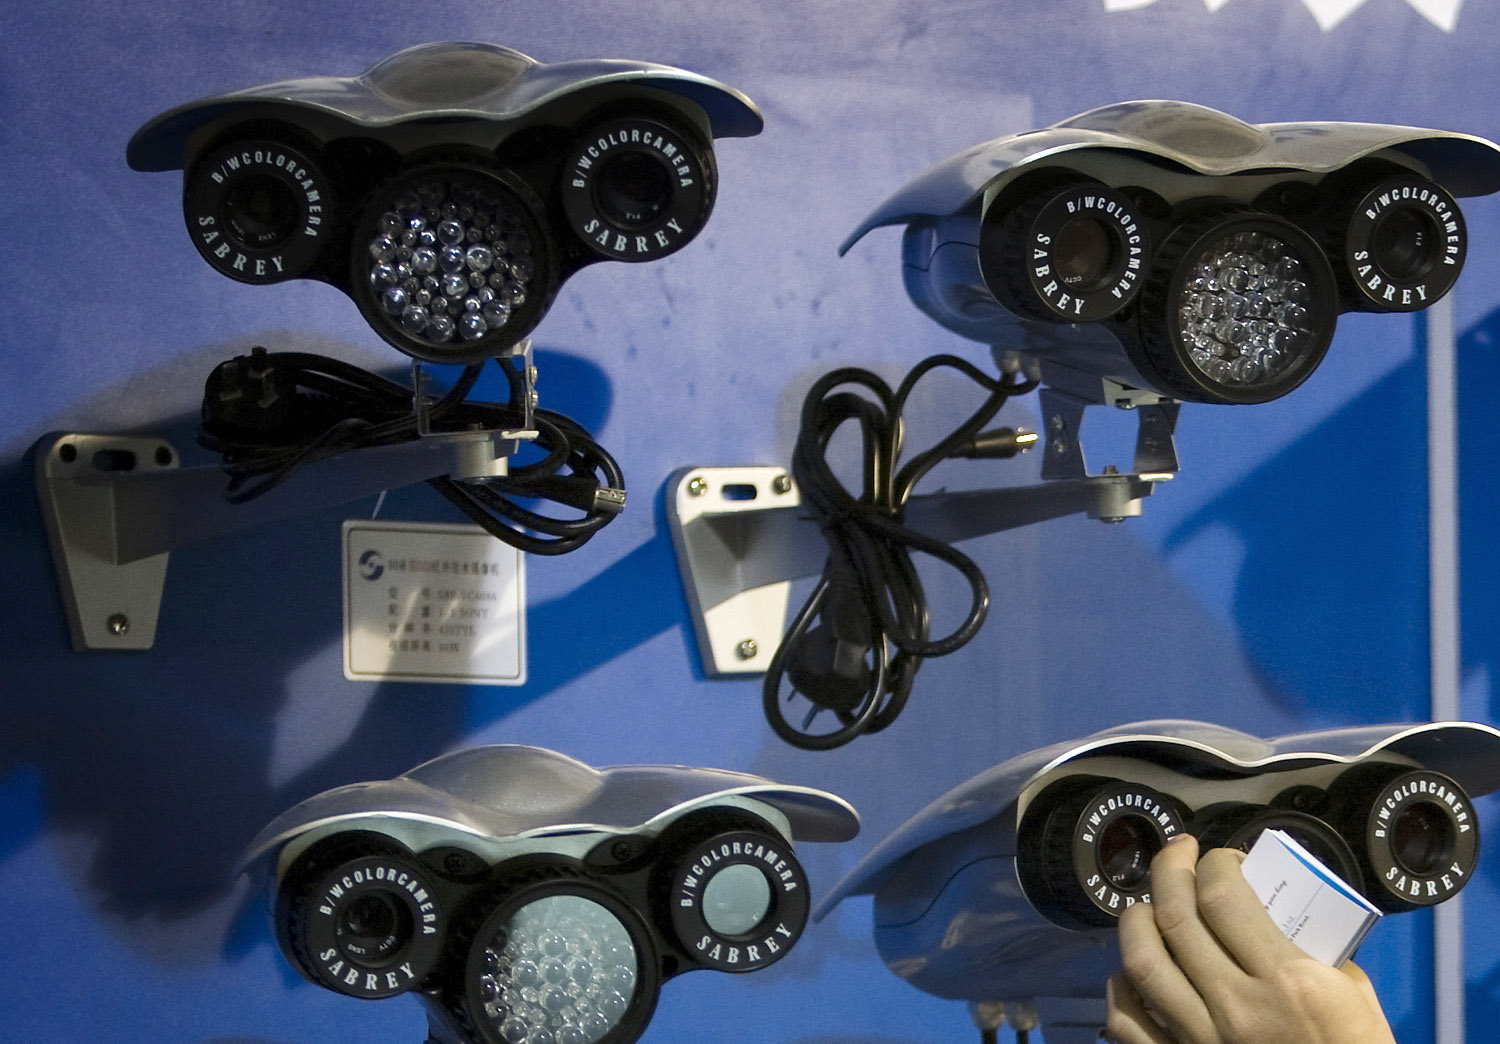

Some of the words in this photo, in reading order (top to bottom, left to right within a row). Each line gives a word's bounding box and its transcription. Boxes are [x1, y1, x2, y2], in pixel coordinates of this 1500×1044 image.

[199, 216, 283, 275] SABREY
[584, 218, 682, 252] SABREY
[1033, 233, 1085, 314] SABREY
[1354, 251, 1426, 304] SABREY
[1083, 794, 1176, 842] B/WCOLORCAME
[1087, 875, 1151, 908] SABRE
[1386, 862, 1464, 896] SABREY
[696, 923, 792, 963] SABREY
[320, 948, 415, 990] SABREY
